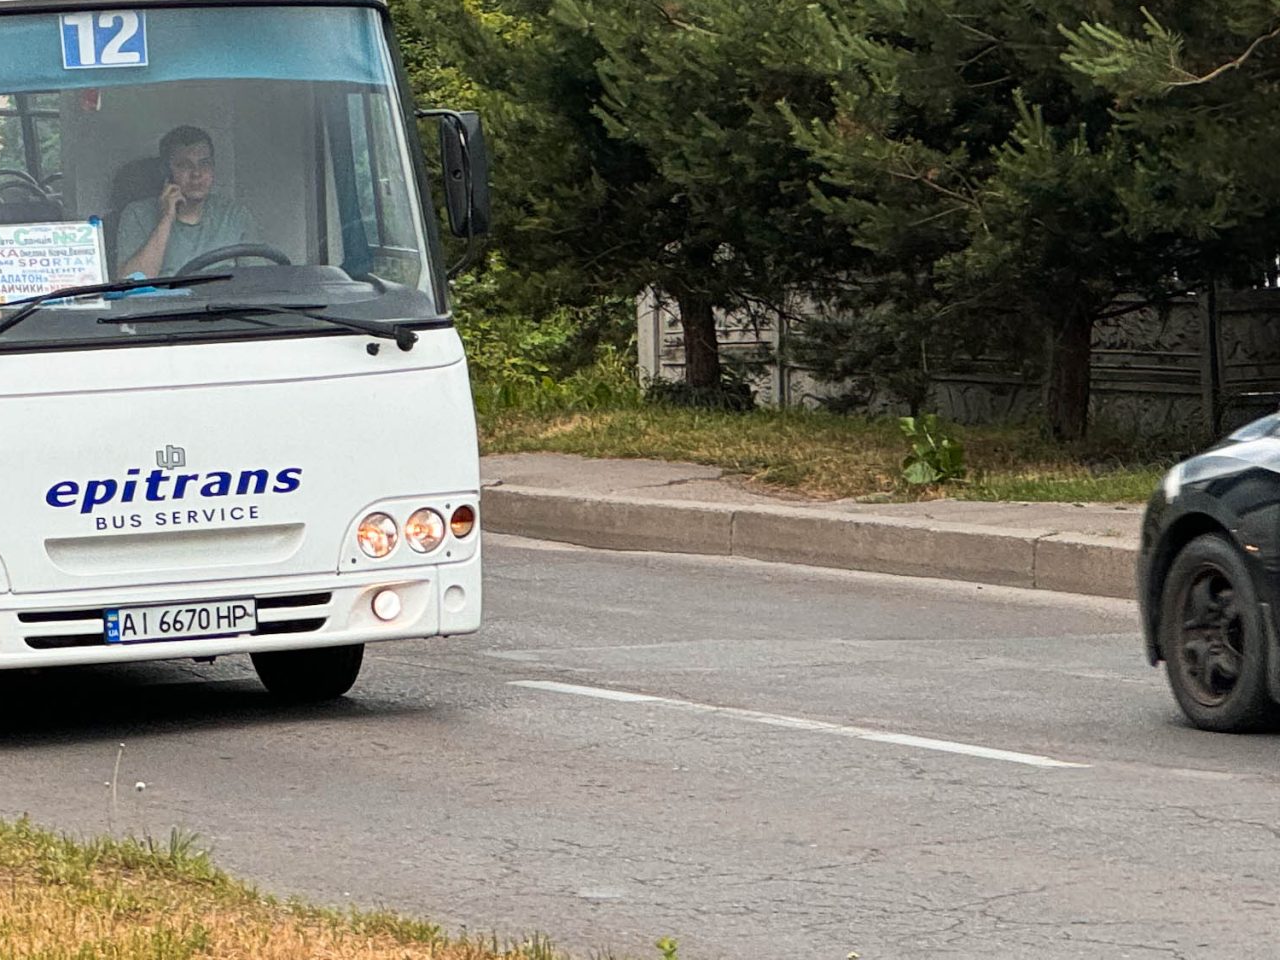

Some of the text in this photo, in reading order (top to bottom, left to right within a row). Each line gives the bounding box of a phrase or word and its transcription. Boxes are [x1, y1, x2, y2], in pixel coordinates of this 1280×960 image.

[64, 10, 140, 65] 12
[45, 467, 303, 515] epitrans
[96, 505, 260, 530] BUS SERVICE
[122, 604, 247, 637] AI 6670 HP
